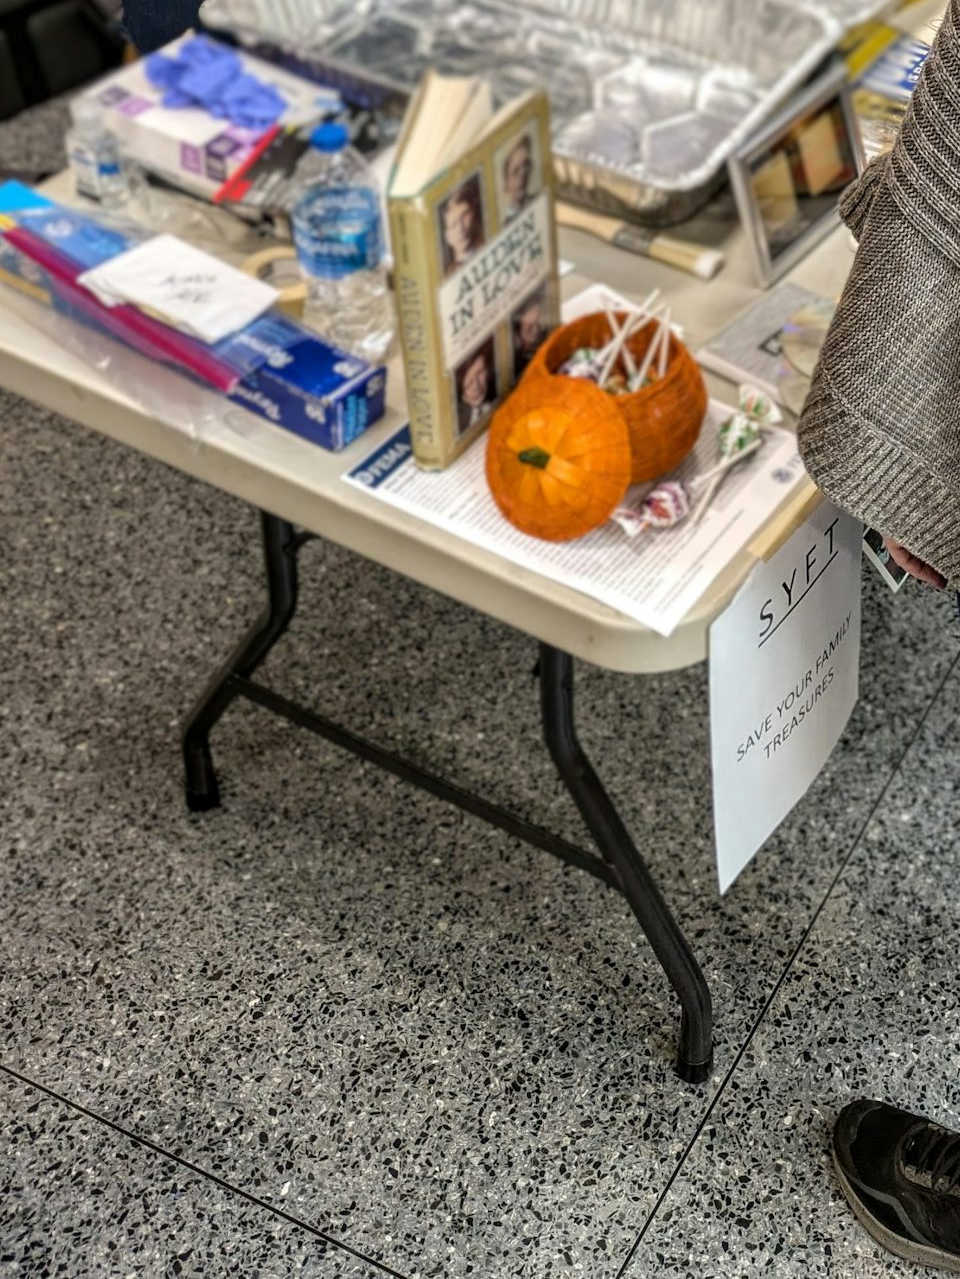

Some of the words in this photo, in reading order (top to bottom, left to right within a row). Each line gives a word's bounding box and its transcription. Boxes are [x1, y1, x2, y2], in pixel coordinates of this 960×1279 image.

[449, 302, 474, 337] IN
[480, 235, 544, 307] LOVE
[456, 213, 538, 304] AUDEN
[400, 275, 426, 352] AUDEN
[407, 357, 427, 383] IN
[411, 388, 434, 445] LOVE
[370, 440, 411, 479] FEMA
[737, 713, 773, 762] SAVE
[776, 670, 813, 719] YOUR
[815, 610, 852, 676] FAMILY
[763, 666, 835, 760] TREASURES
